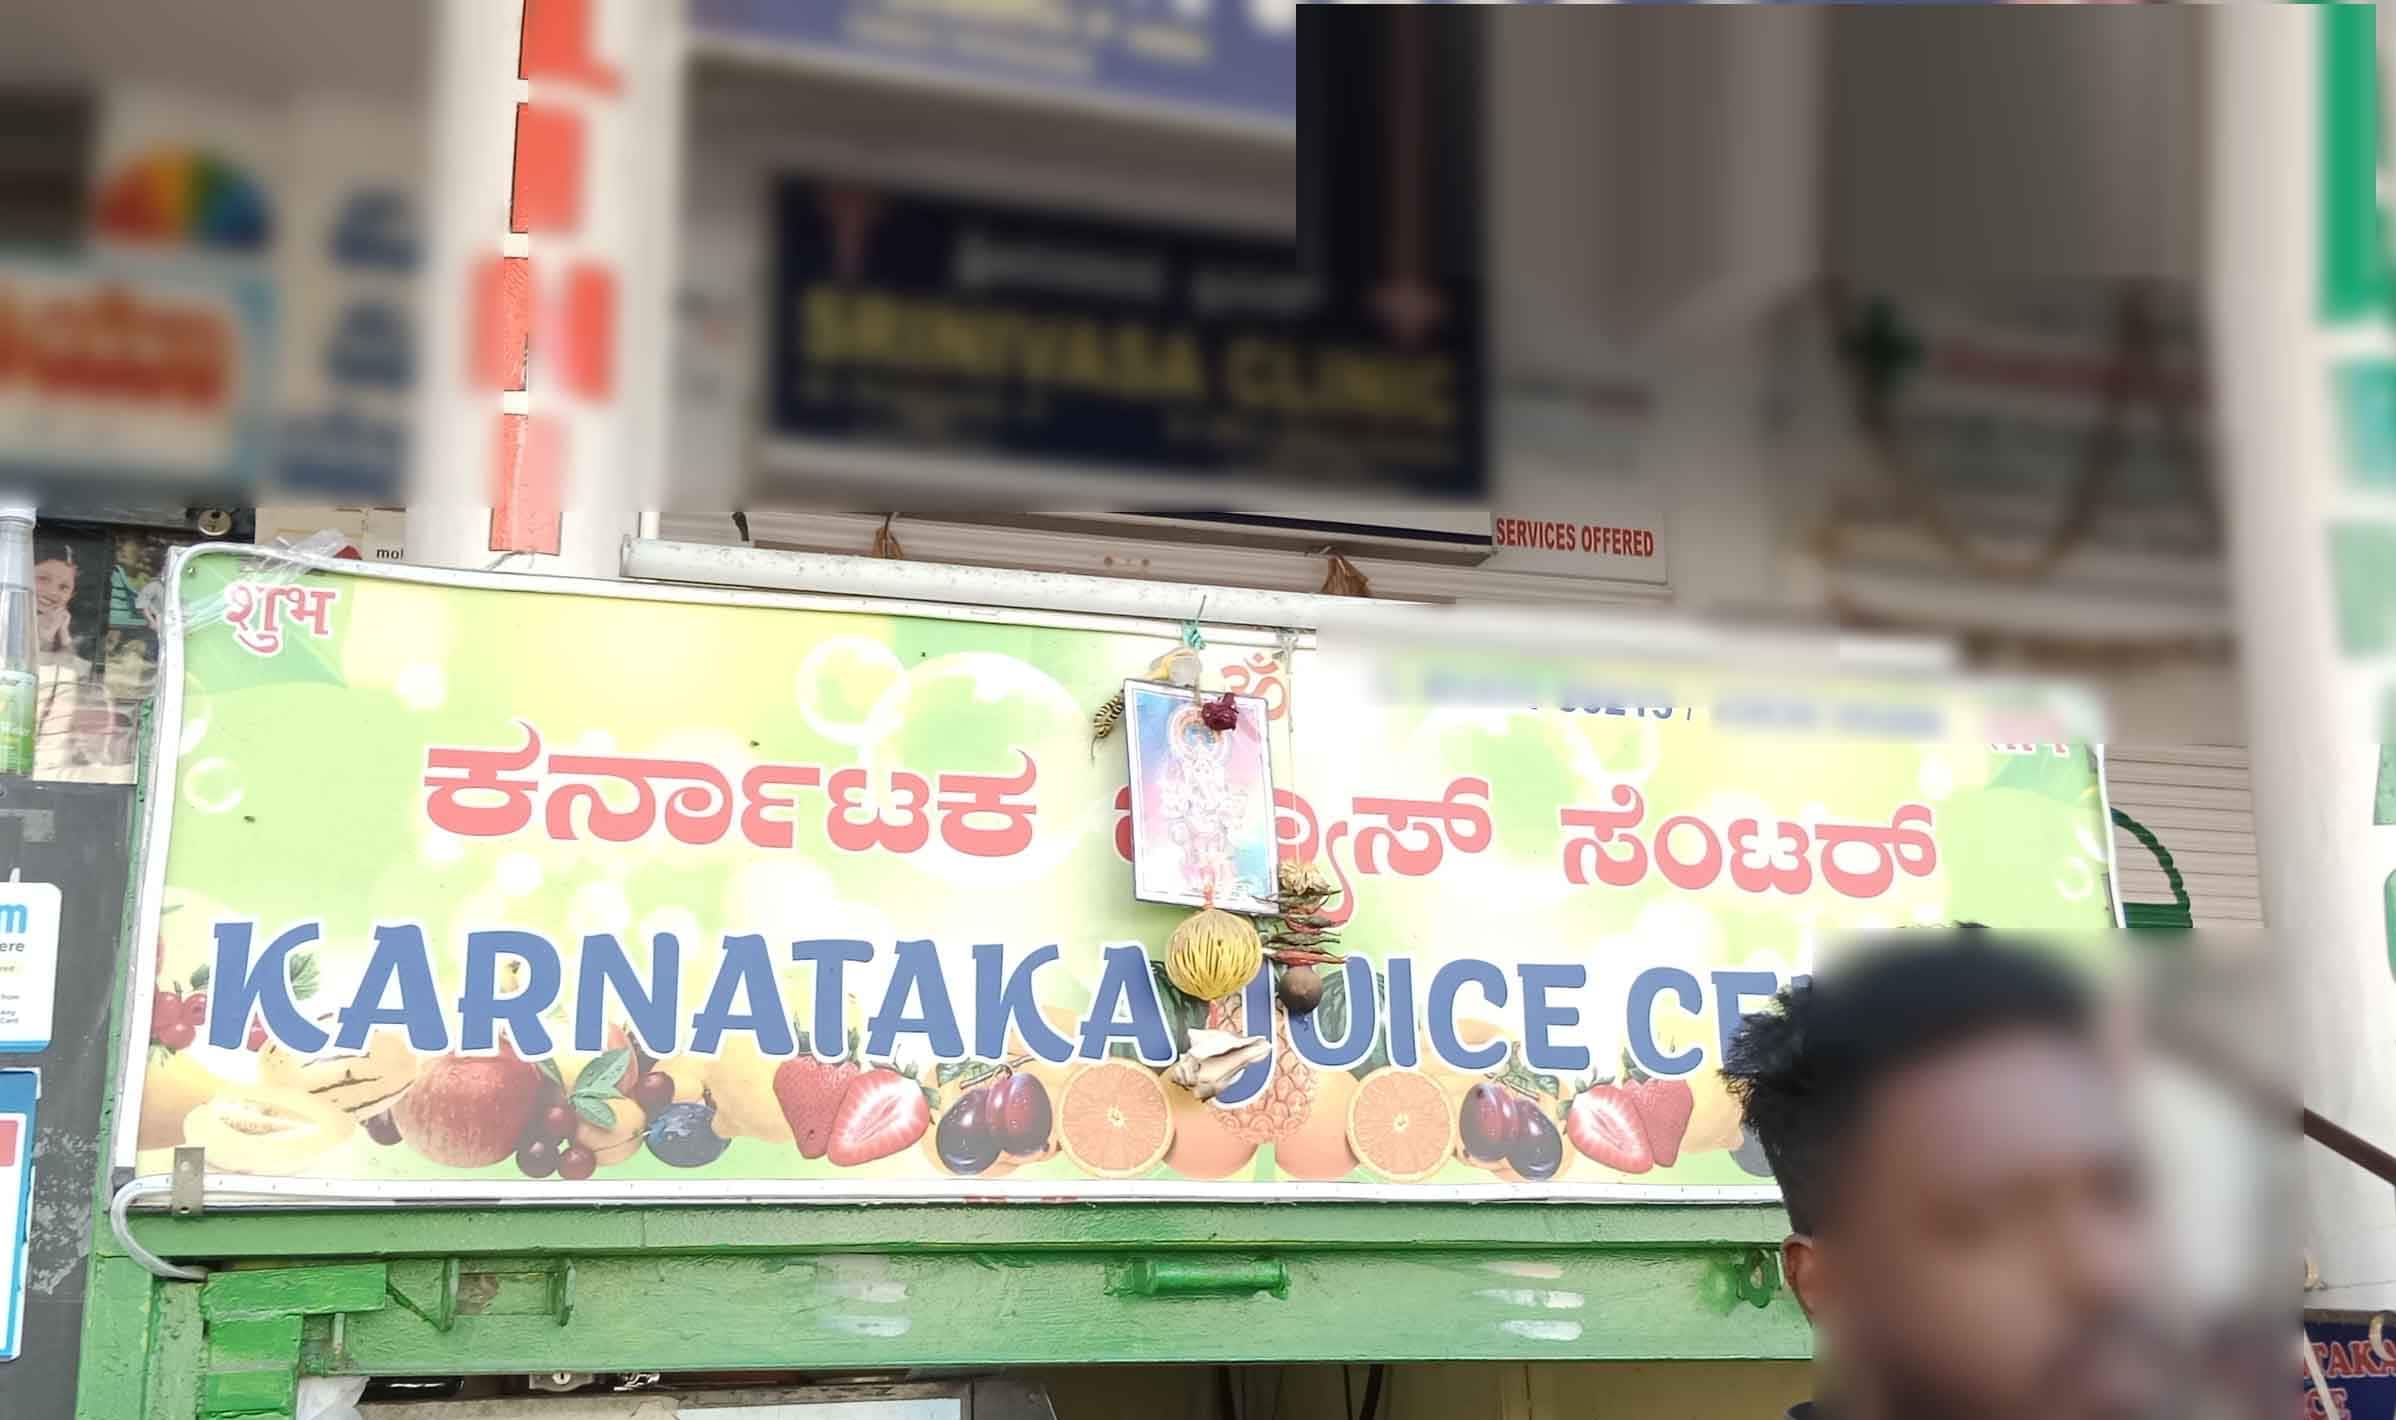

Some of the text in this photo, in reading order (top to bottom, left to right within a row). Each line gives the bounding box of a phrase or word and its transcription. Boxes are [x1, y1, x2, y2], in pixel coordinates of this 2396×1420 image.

[1496, 518, 1654, 557] SERVICES OFFERED
[424, 720, 1037, 857] ಕರ್ನಾಟಕ
[1560, 784, 1937, 898] ಸೆಂಟರ್
[208, 922, 1176, 1062] KARNATAKA
[1214, 955, 1590, 1103] JUICE
